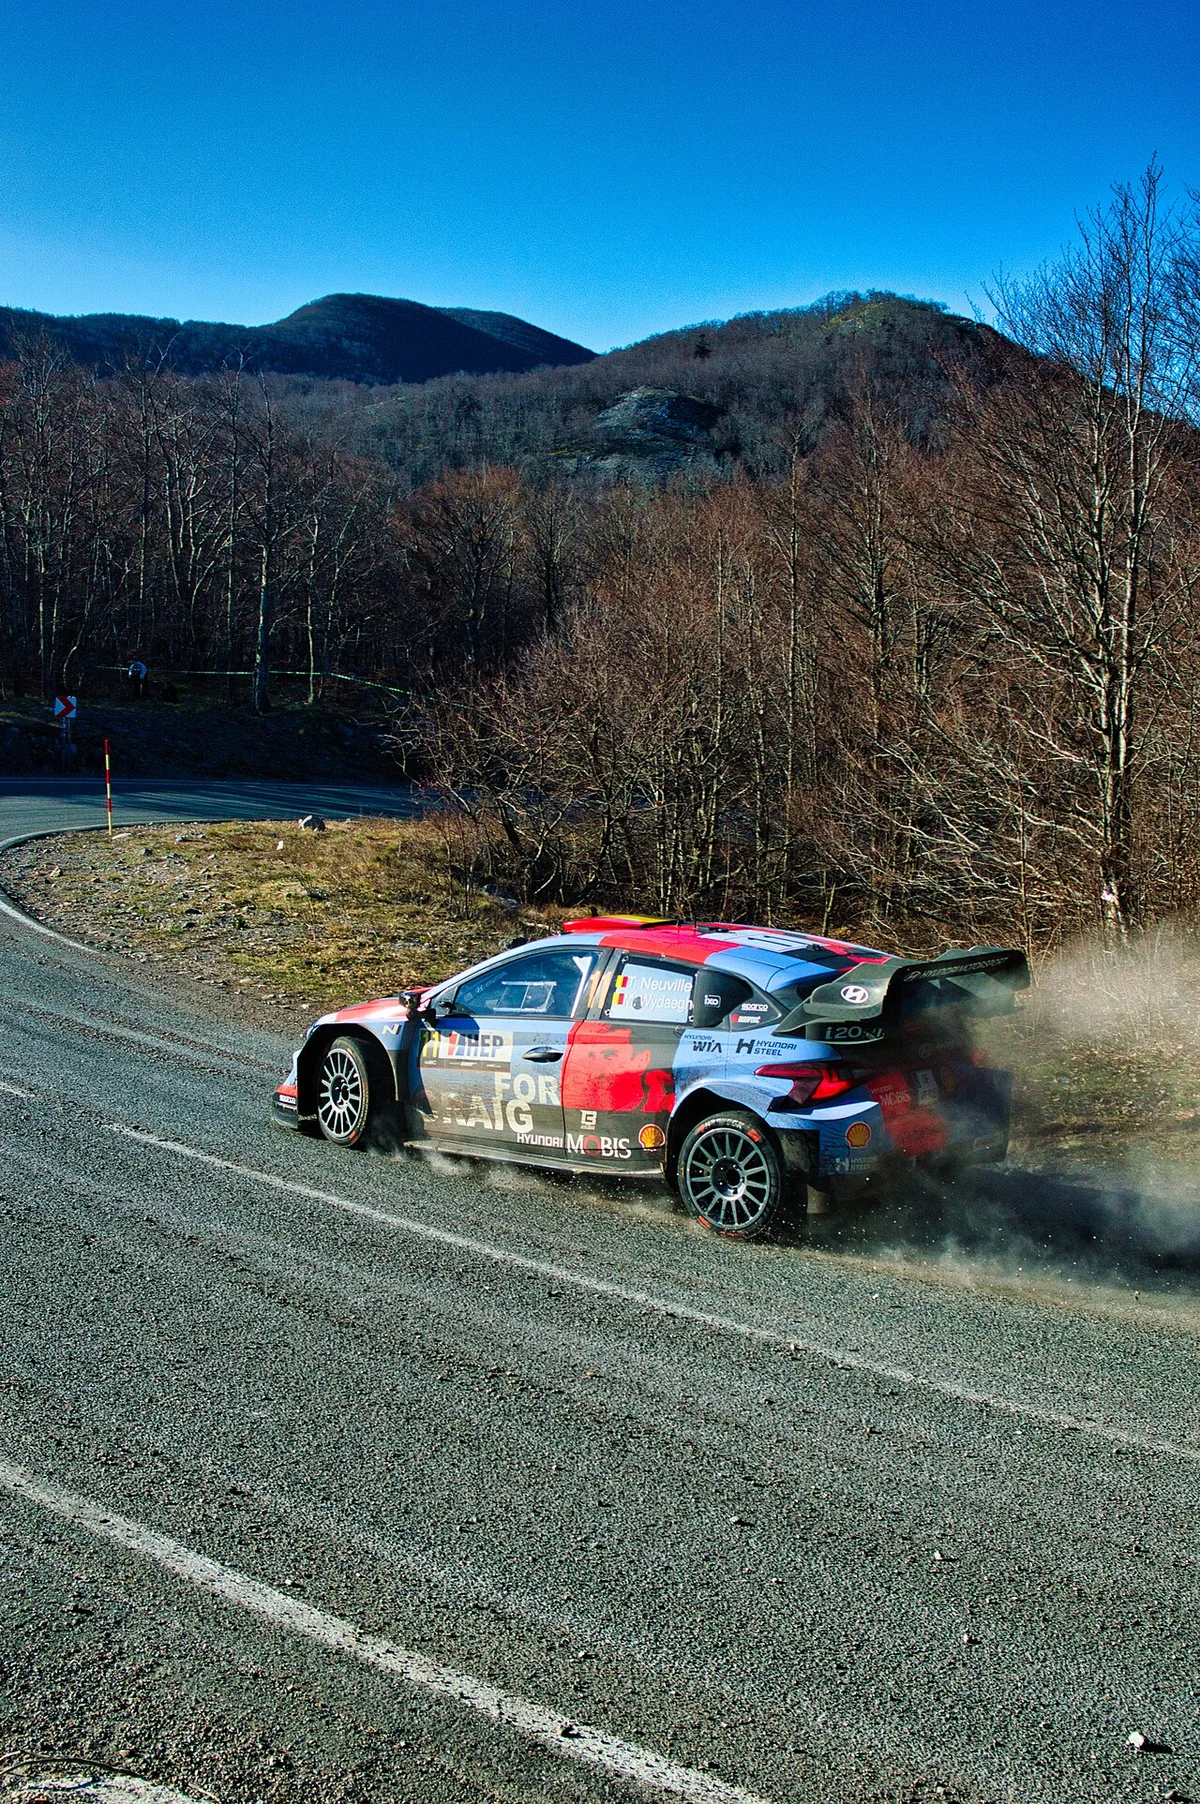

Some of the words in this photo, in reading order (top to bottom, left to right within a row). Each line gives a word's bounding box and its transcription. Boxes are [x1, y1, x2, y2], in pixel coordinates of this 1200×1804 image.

[627, 976, 637, 989] T.
[640, 977, 693, 992] Neuville
[640, 994, 695, 1012] Wydaegh
[741, 1003, 769, 1012] sparco
[754, 1048, 782, 1057] STEEL
[756, 1040, 797, 1051] HYUNDAI
[494, 1072, 561, 1105] FOR
[879, 1089, 911, 1107] MOBIS
[516, 1132, 563, 1148] HYUNDAI
[566, 1133, 632, 1159] MOBIS
